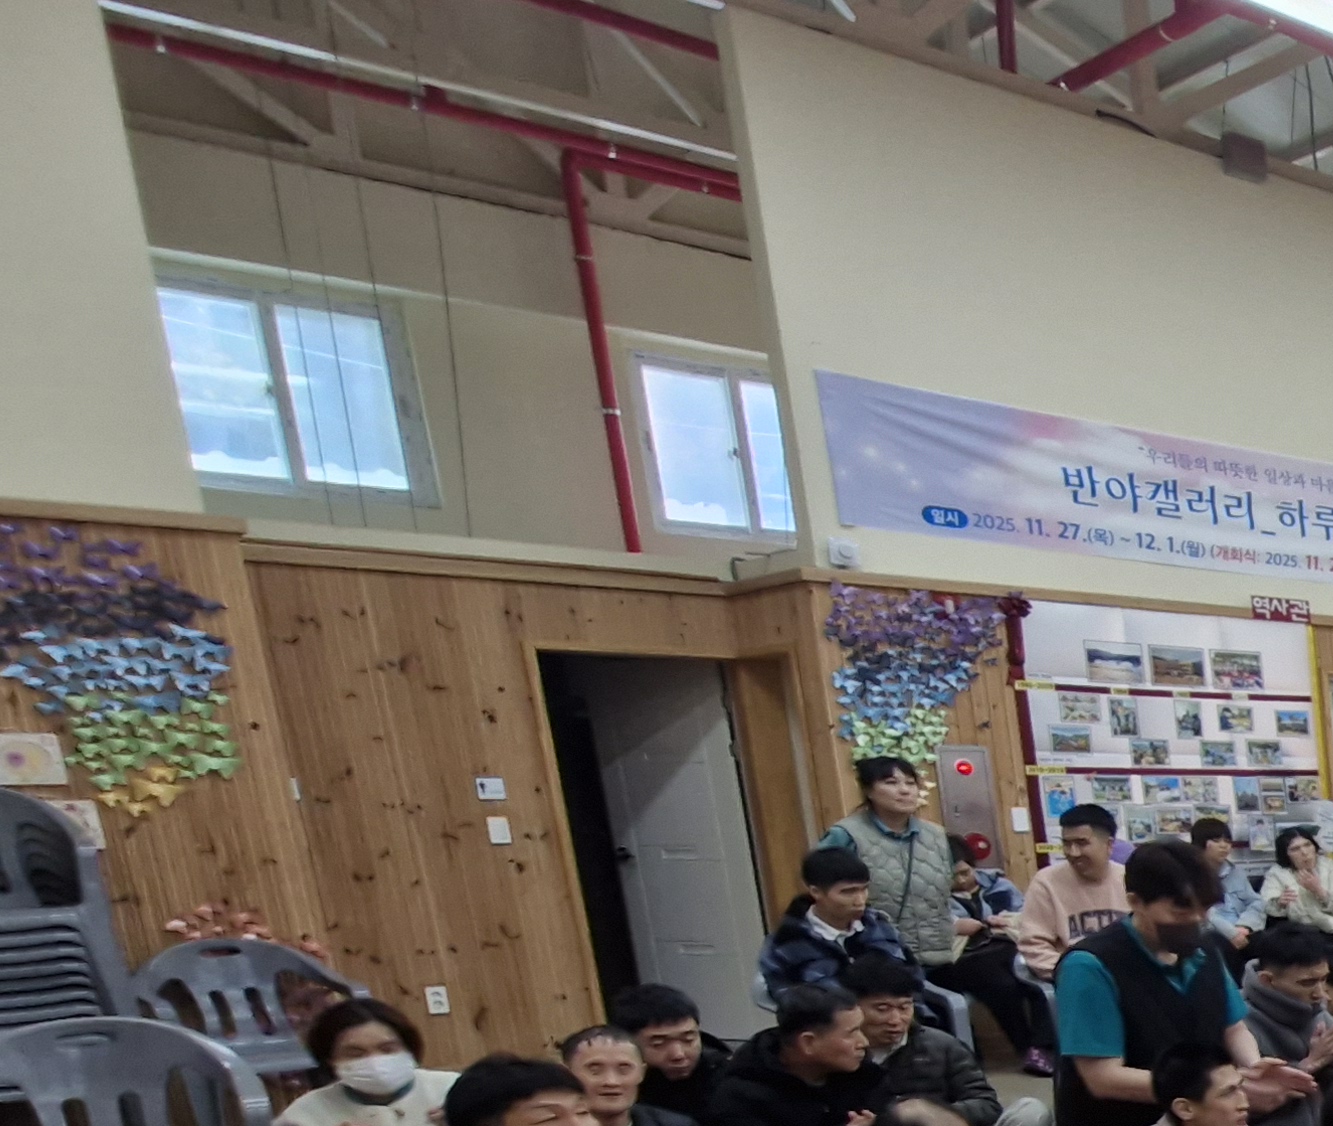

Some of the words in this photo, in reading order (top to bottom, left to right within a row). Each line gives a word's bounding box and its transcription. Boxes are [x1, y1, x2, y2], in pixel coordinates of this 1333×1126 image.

[1213, 459, 1258, 482] 따뜻한
[1264, 467, 1306, 489] 일상과
[930, 507, 960, 526] 일시
[971, 512, 1020, 533] 2025.
[1026, 517, 1051, 538] 11.
[1136, 531, 1163, 552] 12.
[1252, 597, 1309, 622] 역사관
